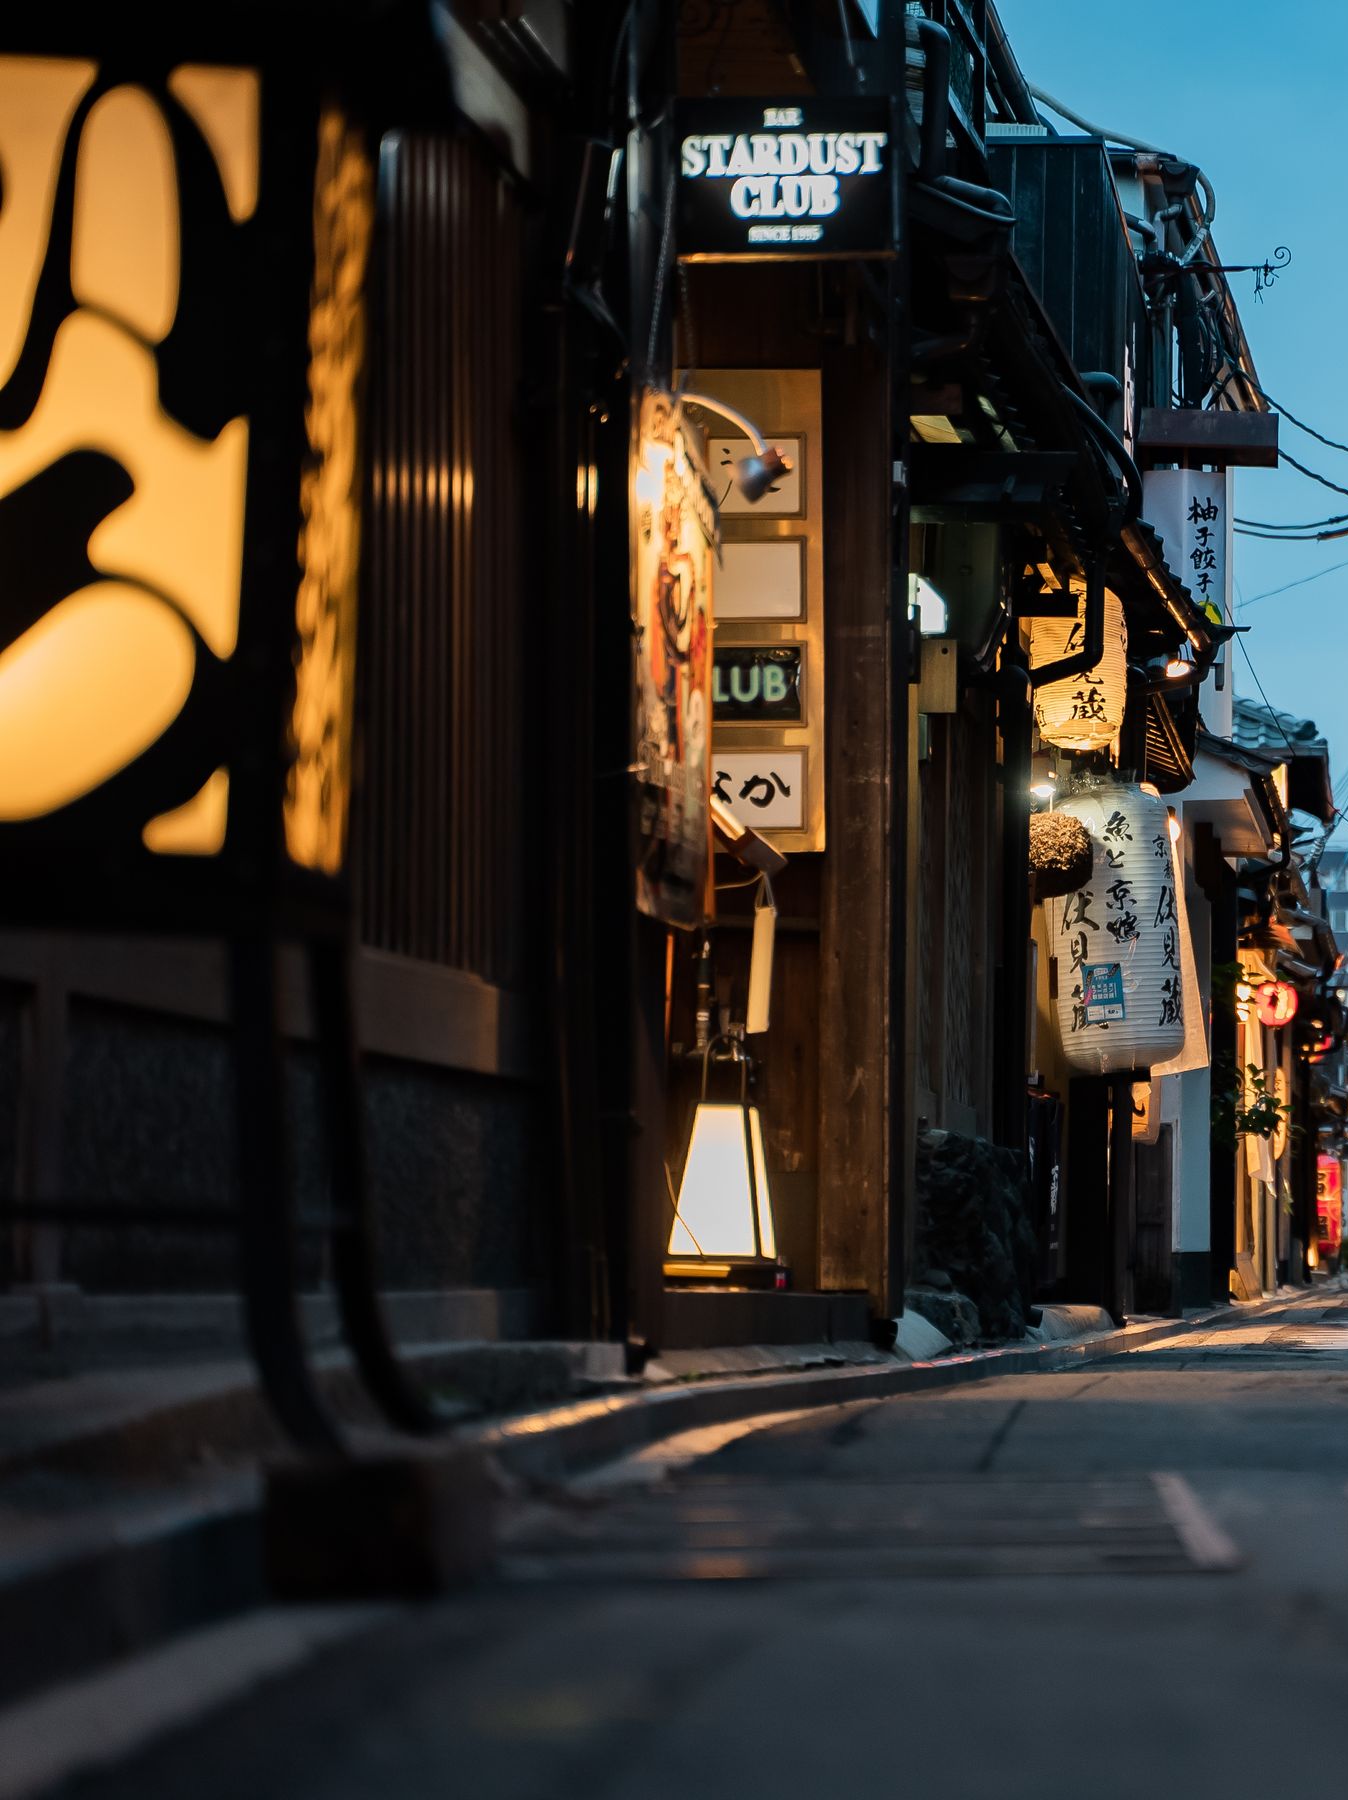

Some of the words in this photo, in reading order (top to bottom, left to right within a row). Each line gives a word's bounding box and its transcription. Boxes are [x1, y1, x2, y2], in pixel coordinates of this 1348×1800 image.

[763, 108, 803, 127] BAR
[681, 132, 887, 176] STARDUST
[730, 174, 840, 219] CLUB
[748, 224, 791, 242] SINCE
[1187, 496, 1218, 593] 柚子餃子
[1103, 811, 1141, 943] 魚と京鴨
